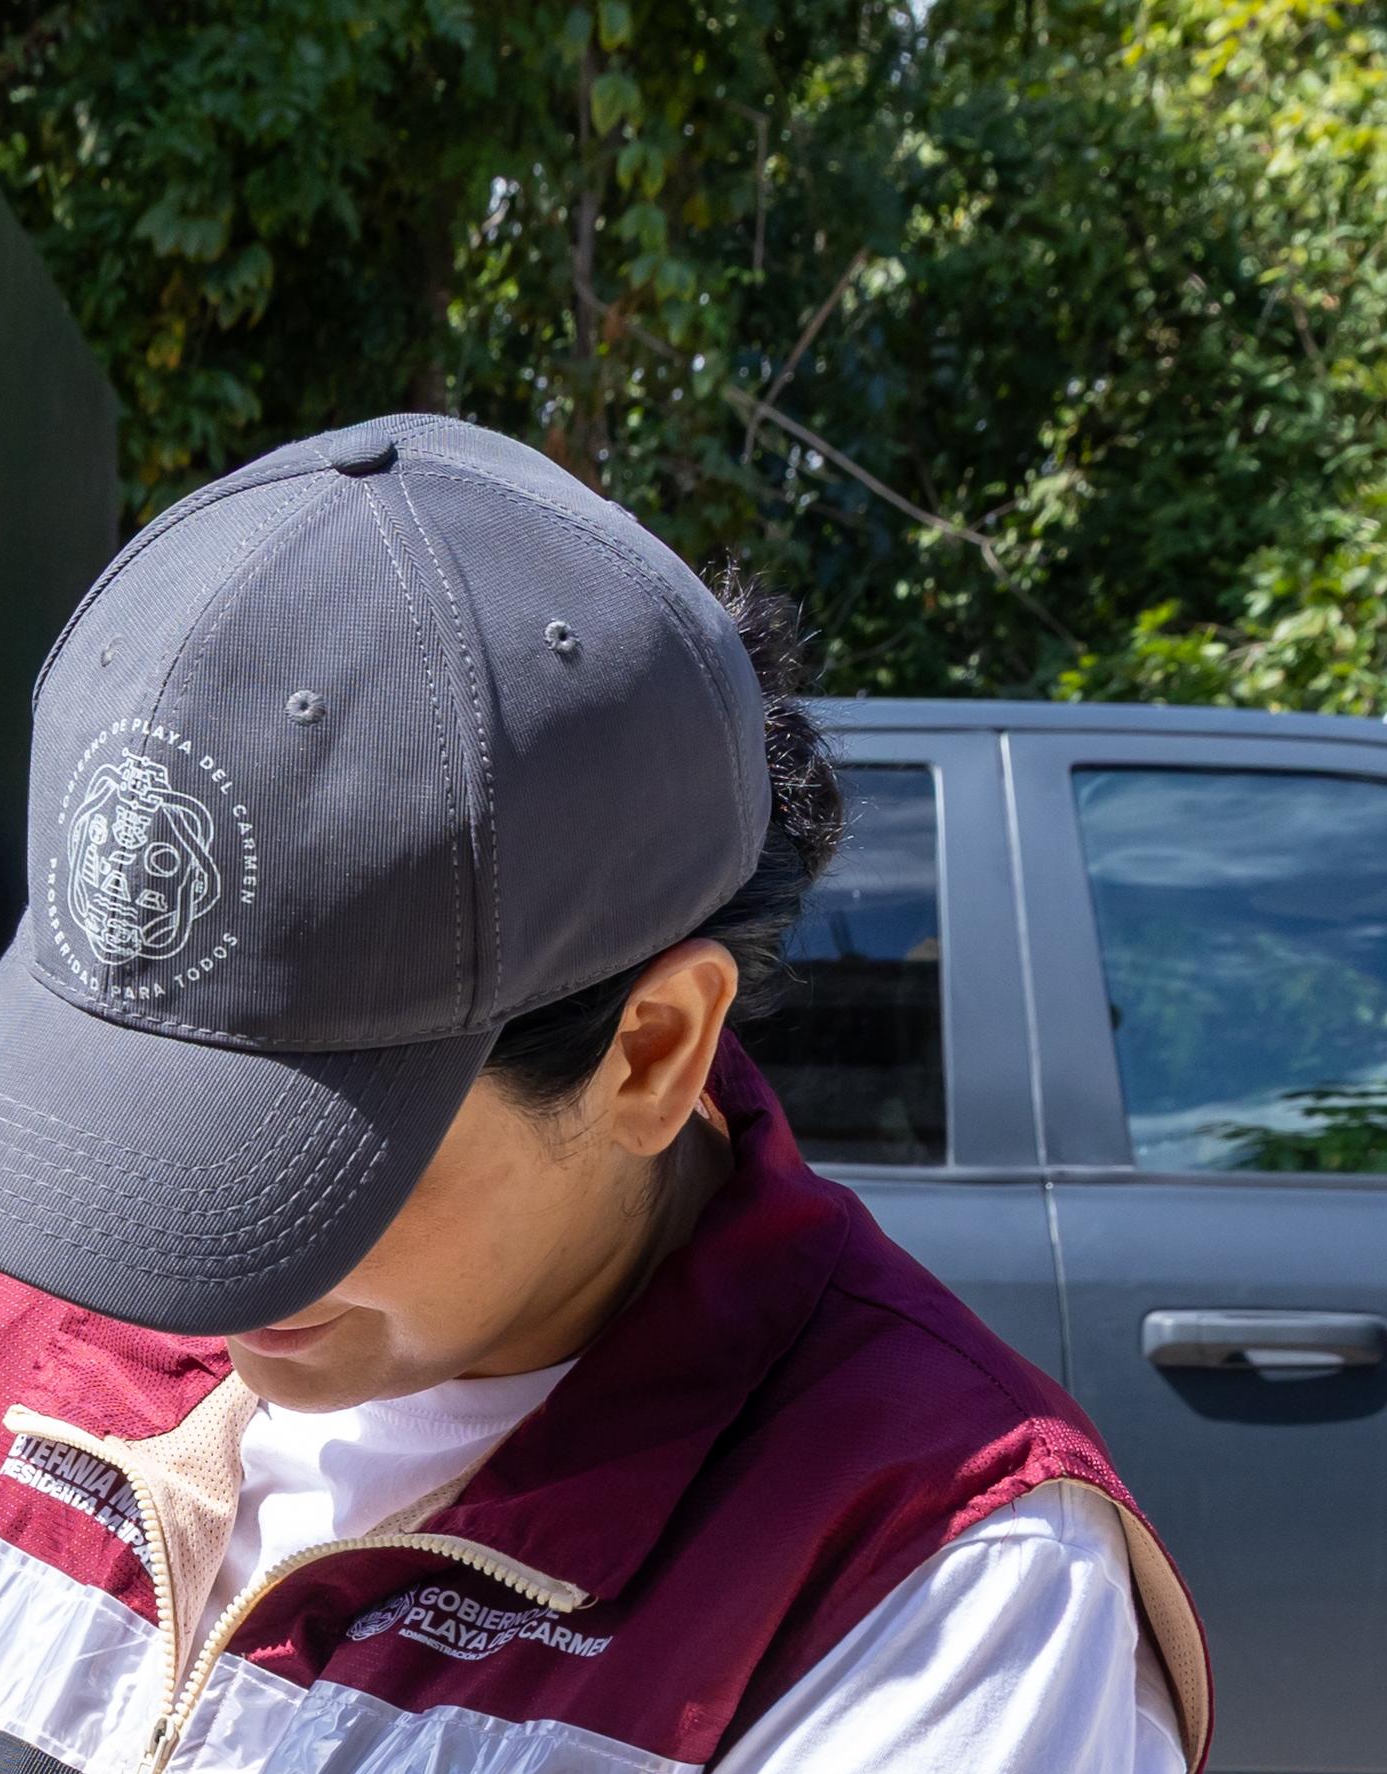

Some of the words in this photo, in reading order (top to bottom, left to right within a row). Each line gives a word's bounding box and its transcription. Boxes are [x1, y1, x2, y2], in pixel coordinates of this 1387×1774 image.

[132, 718, 192, 754] PLAYA
[200, 755, 233, 795] DEL
[233, 804, 258, 904] CARMEN
[111, 983, 166, 1000] PARA
[174, 933, 238, 989] TODOS
[403, 1607, 488, 1651] PLAYA
